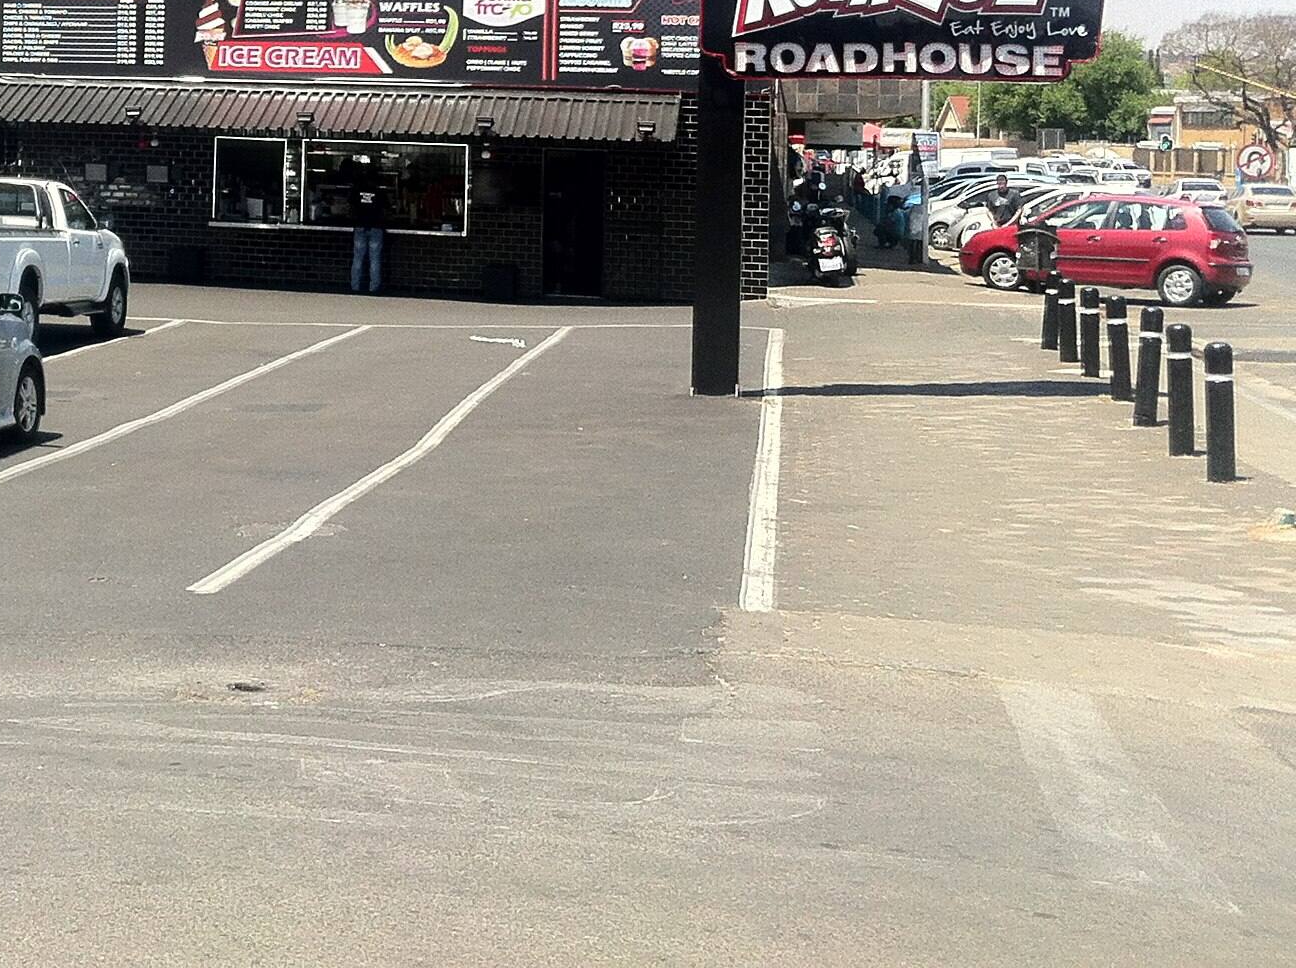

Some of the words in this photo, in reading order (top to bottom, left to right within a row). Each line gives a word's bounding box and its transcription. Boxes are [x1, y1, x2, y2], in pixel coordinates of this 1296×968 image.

[379, 2, 441, 13] WAFFLES
[1049, 6, 1070, 18] TM
[950, 22, 984, 37] Eat
[991, 21, 1037, 39] Enjoy
[1047, 21, 1088, 38] Love
[218, 46, 262, 67] ICE
[265, 46, 361, 69] CREAM
[734, 42, 1065, 76] ROADHOUSE
